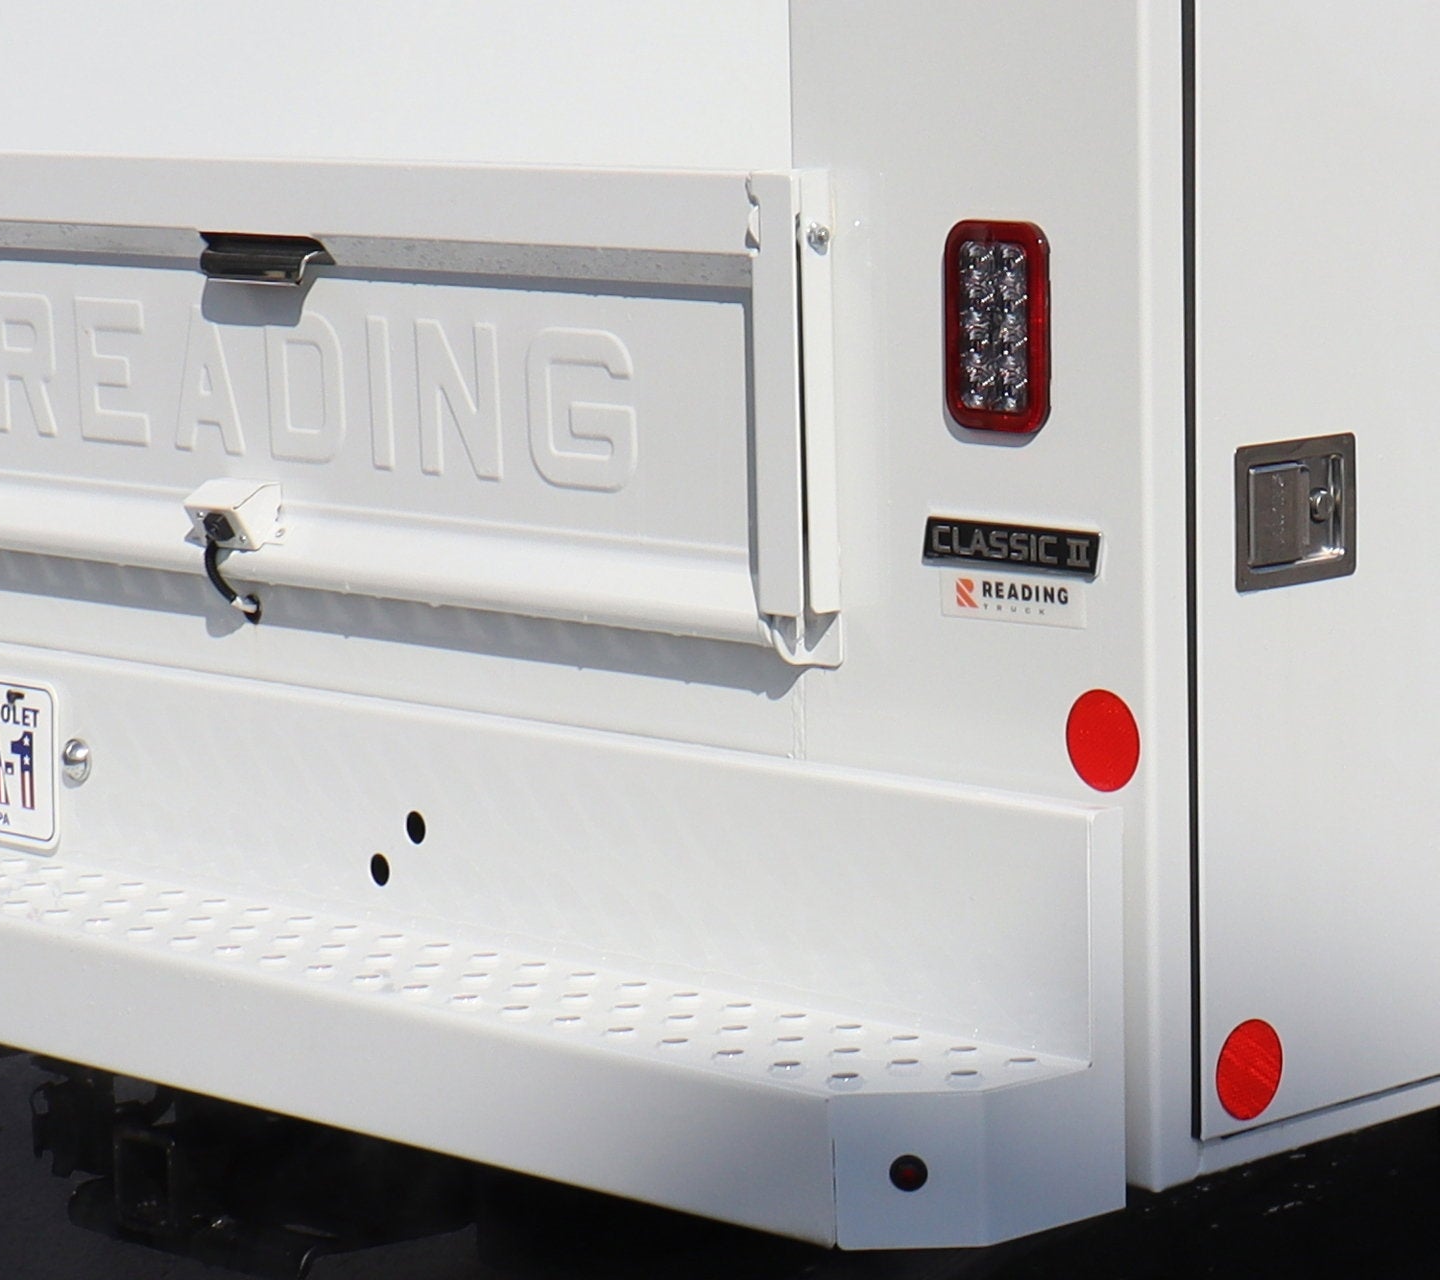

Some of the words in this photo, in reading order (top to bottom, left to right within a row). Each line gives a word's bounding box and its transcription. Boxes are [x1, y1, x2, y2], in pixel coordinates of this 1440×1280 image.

[932, 525, 1058, 564] CLASSIC
[1066, 538, 1090, 567] II
[982, 581, 1069, 605] READING
[983, 603, 1045, 615] TRUCK
